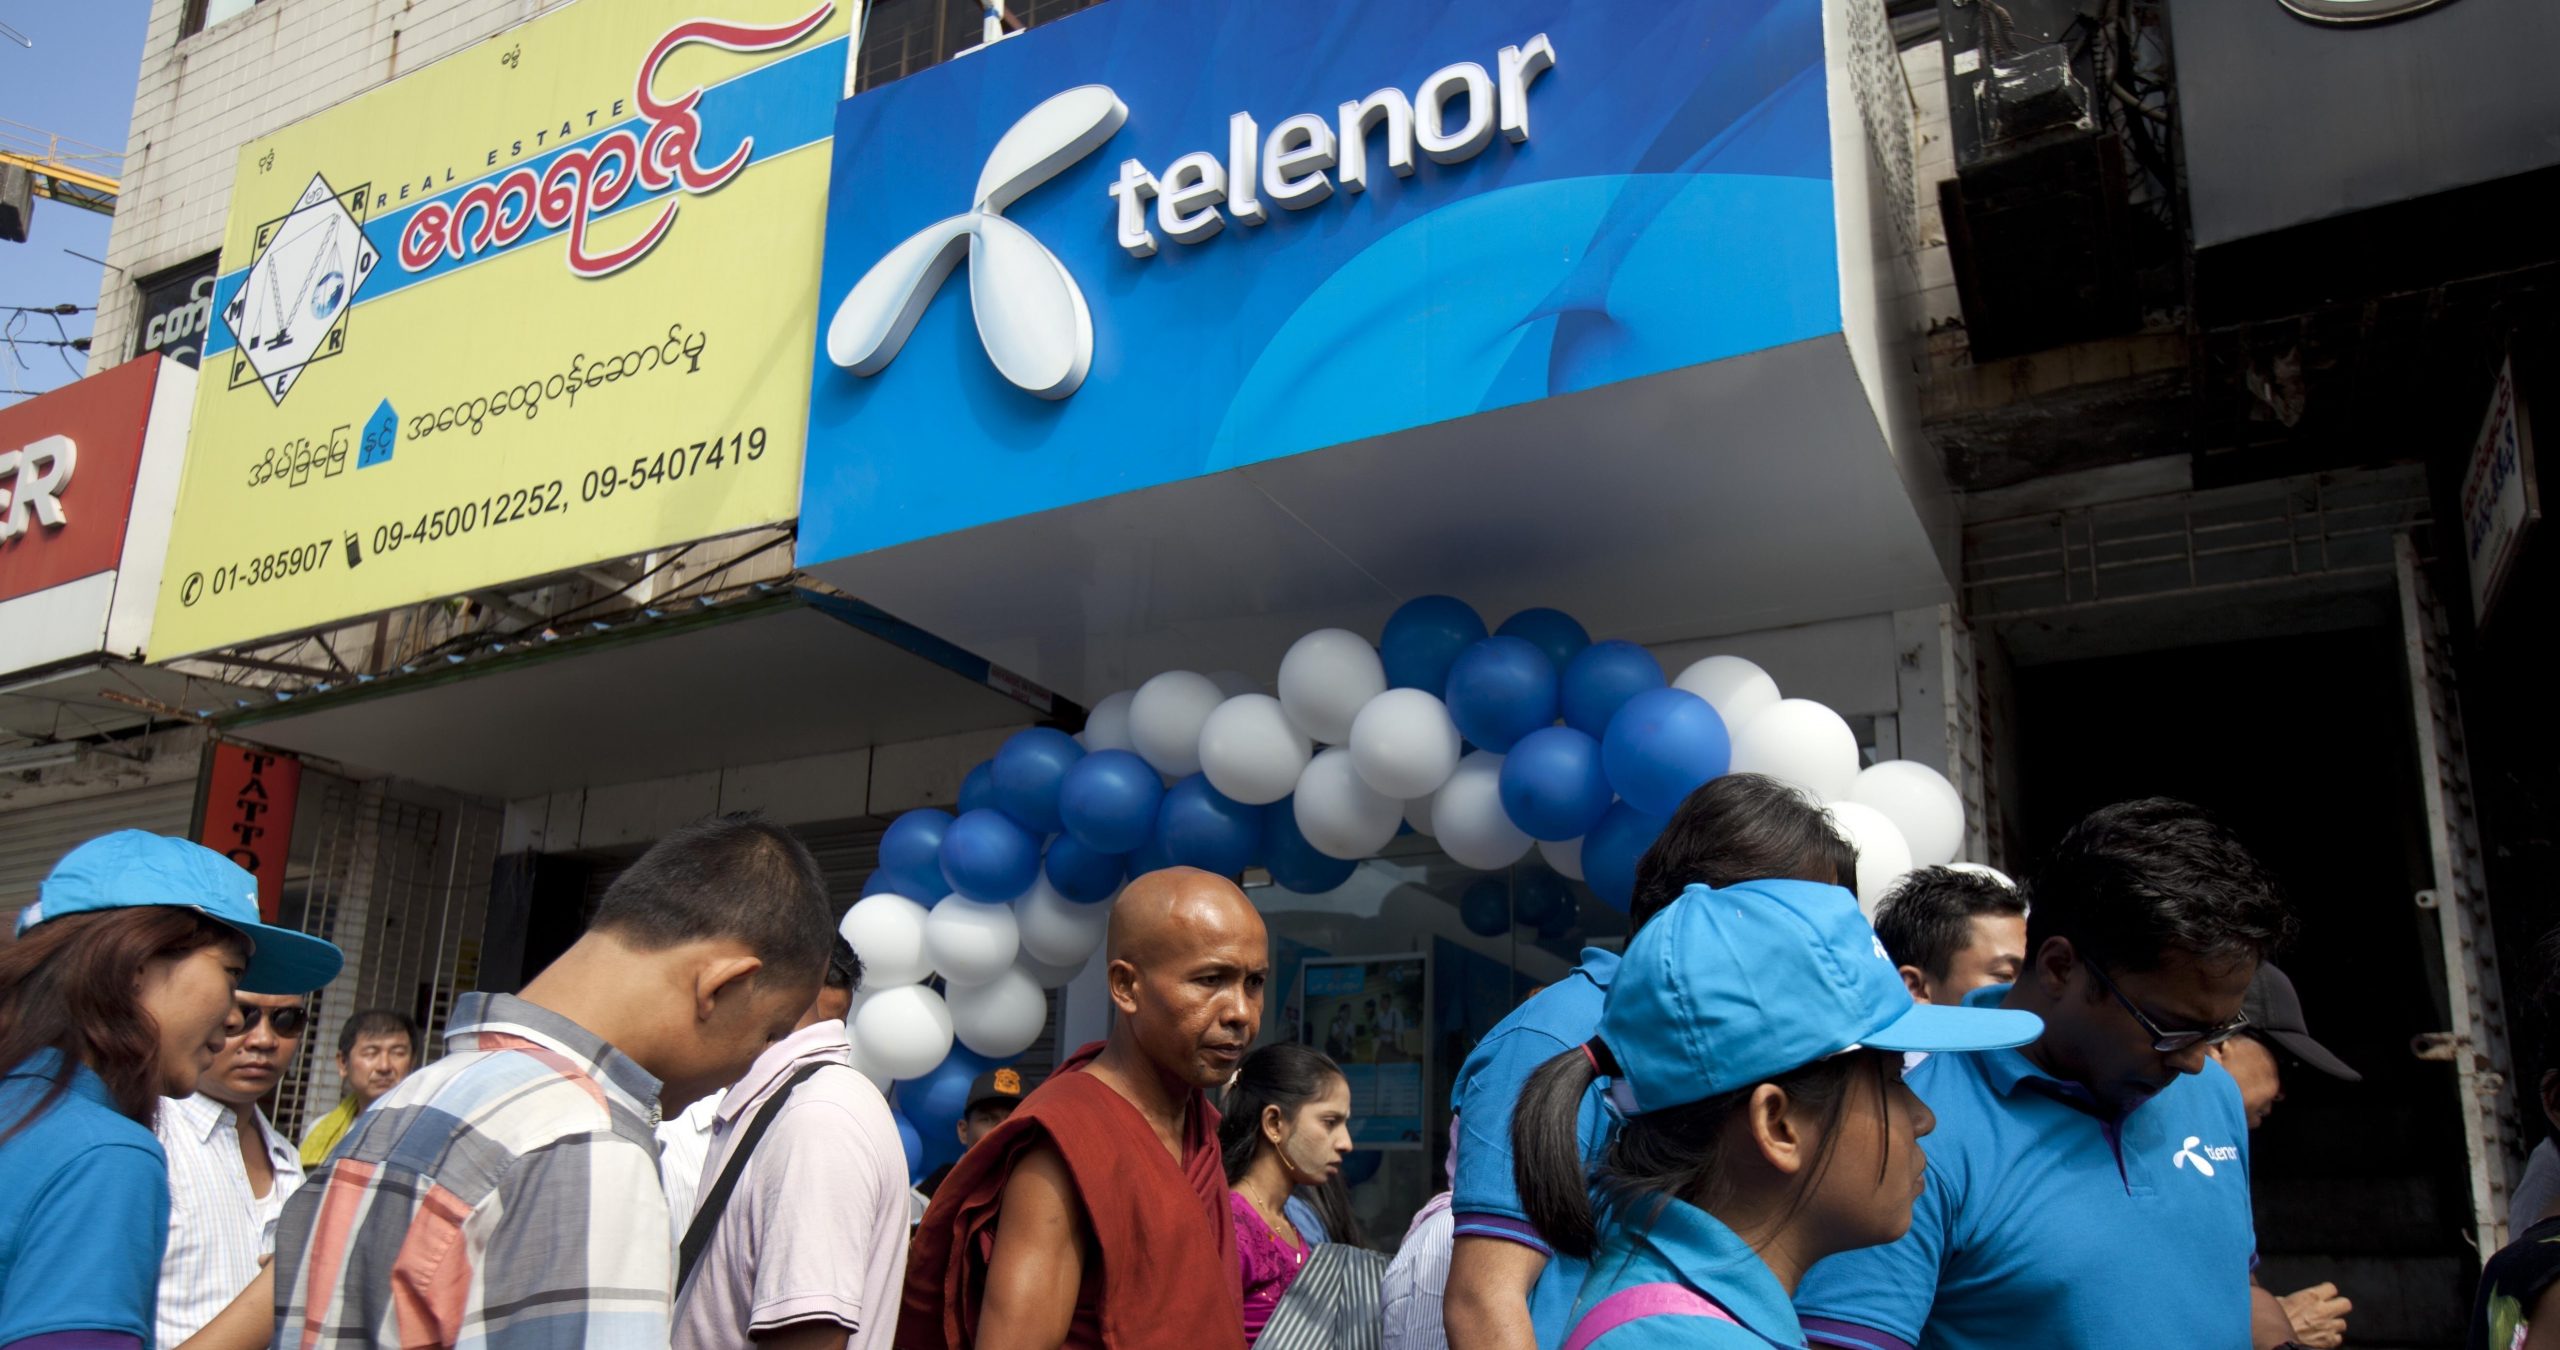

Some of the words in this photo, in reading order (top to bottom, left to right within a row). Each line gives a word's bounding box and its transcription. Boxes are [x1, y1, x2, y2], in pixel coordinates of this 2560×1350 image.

[376, 167, 455, 209] REAL
[486, 99, 625, 166] ESTATE
[1109, 33, 1556, 258] telenor
[213, 538, 333, 594] 01-385907
[373, 479, 568, 555] 09-450012252,
[582, 426, 767, 502] 09-5407419
